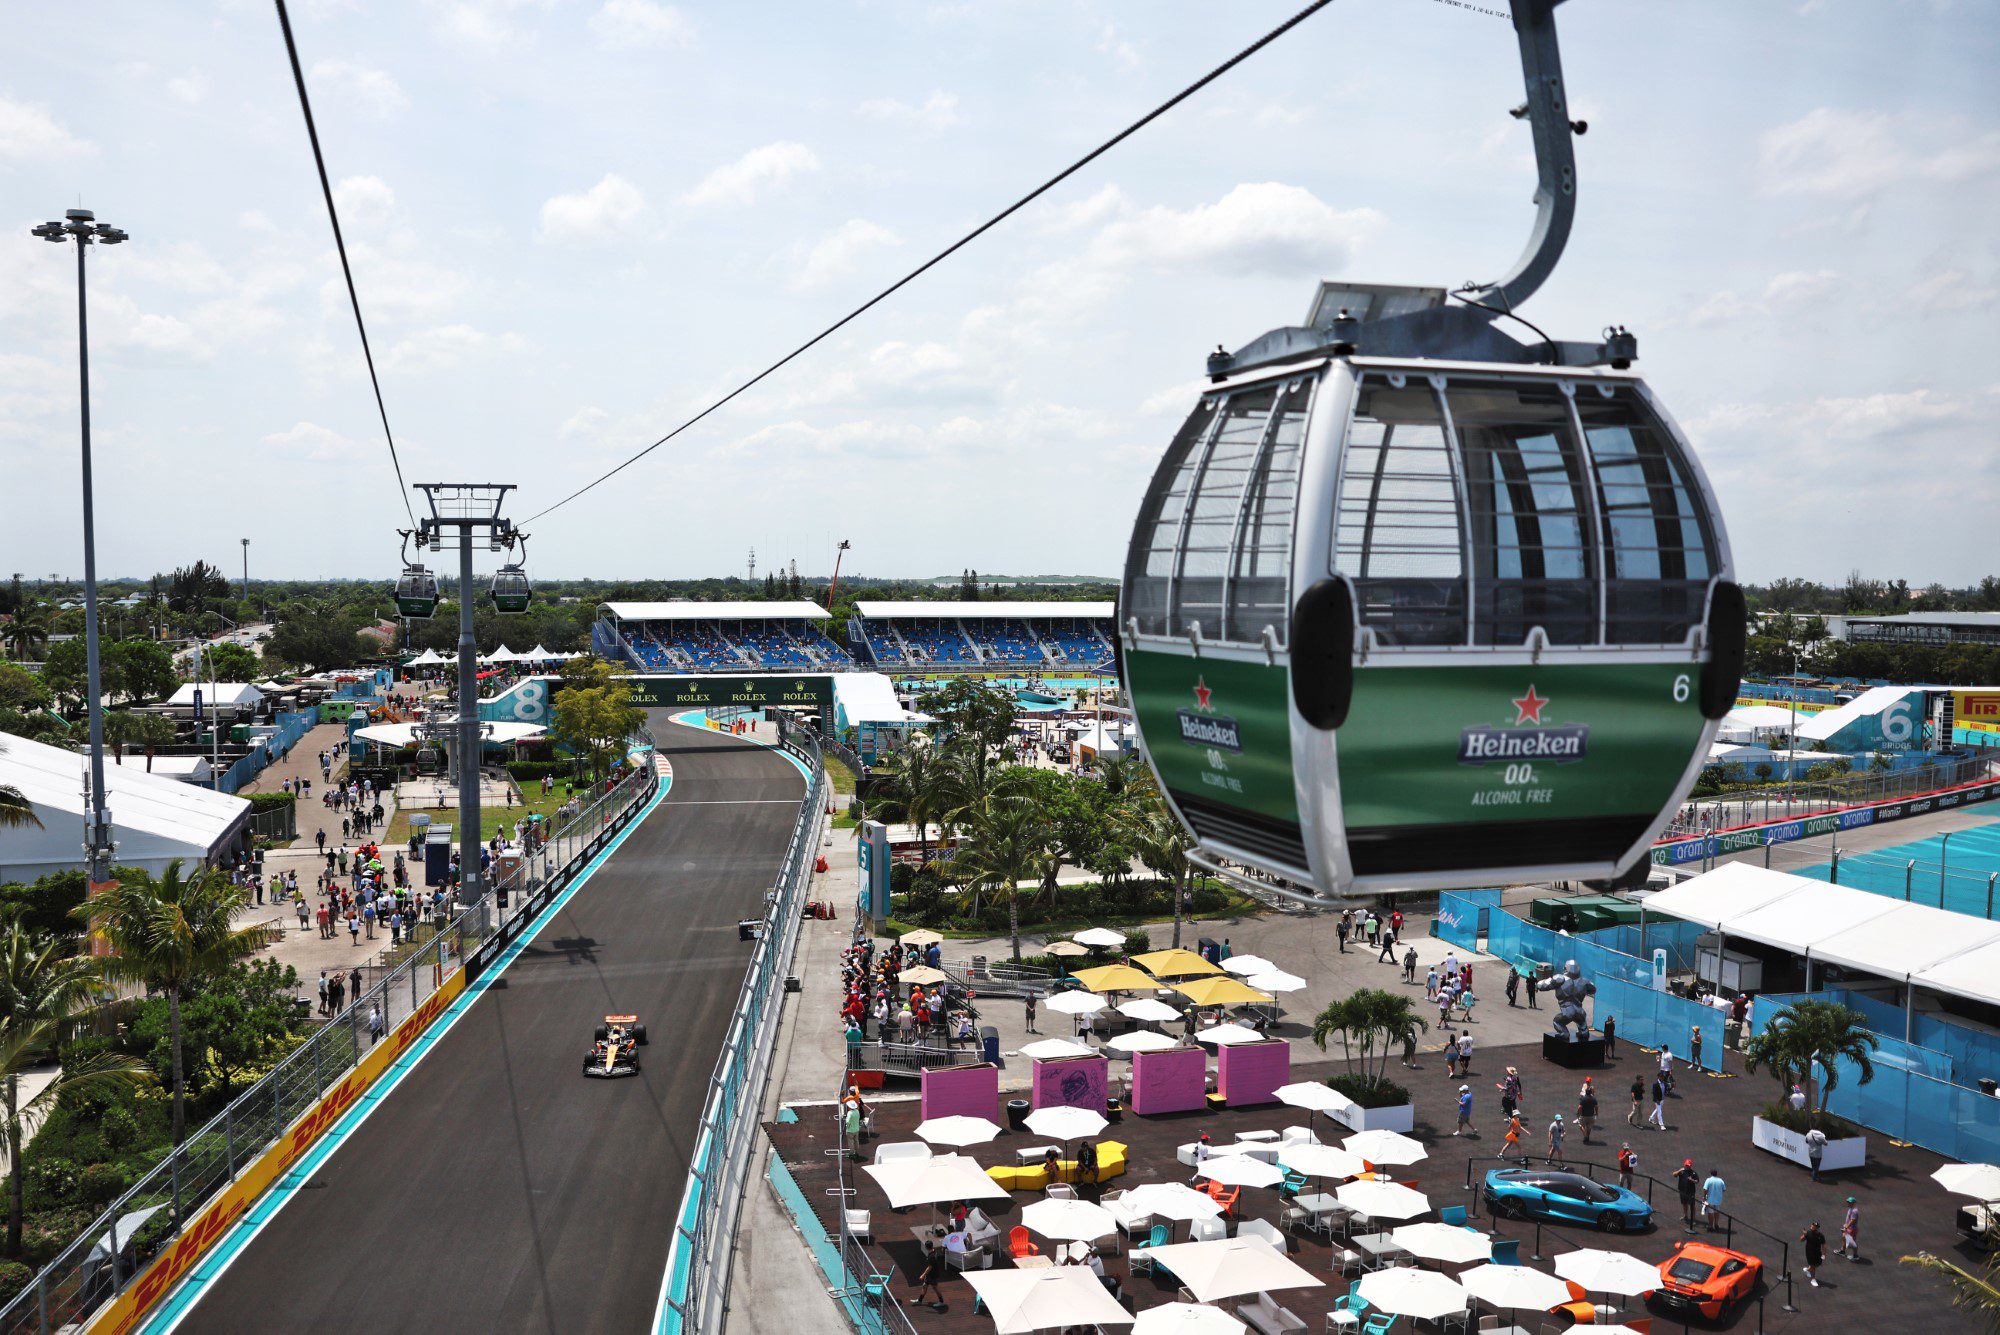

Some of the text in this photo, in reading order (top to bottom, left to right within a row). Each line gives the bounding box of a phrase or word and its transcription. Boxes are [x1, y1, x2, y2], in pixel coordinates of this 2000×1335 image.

[677, 694, 710, 702] ROLEX
[732, 693, 766, 701] ROLEX
[783, 693, 817, 701] ROLEX
[1673, 674, 1690, 702] 6
[513, 682, 544, 720] 8
[1180, 715, 1239, 747] Heineken
[1881, 700, 1913, 742] 6
[1465, 732, 1580, 757] Heineken
[1882, 742, 1912, 750] BRIDGE
[1471, 789, 1554, 805] ALCOHOL FREE
[1844, 812, 1871, 826] aramco
[1724, 832, 1758, 850] aramco
[1768, 824, 1800, 839] aramco
[861, 845, 867, 869] 5
[1677, 841, 1714, 859] aramo
[397, 994, 442, 1048] DHL
[292, 1079, 356, 1152] DHL
[132, 1202, 227, 1320] DHL
